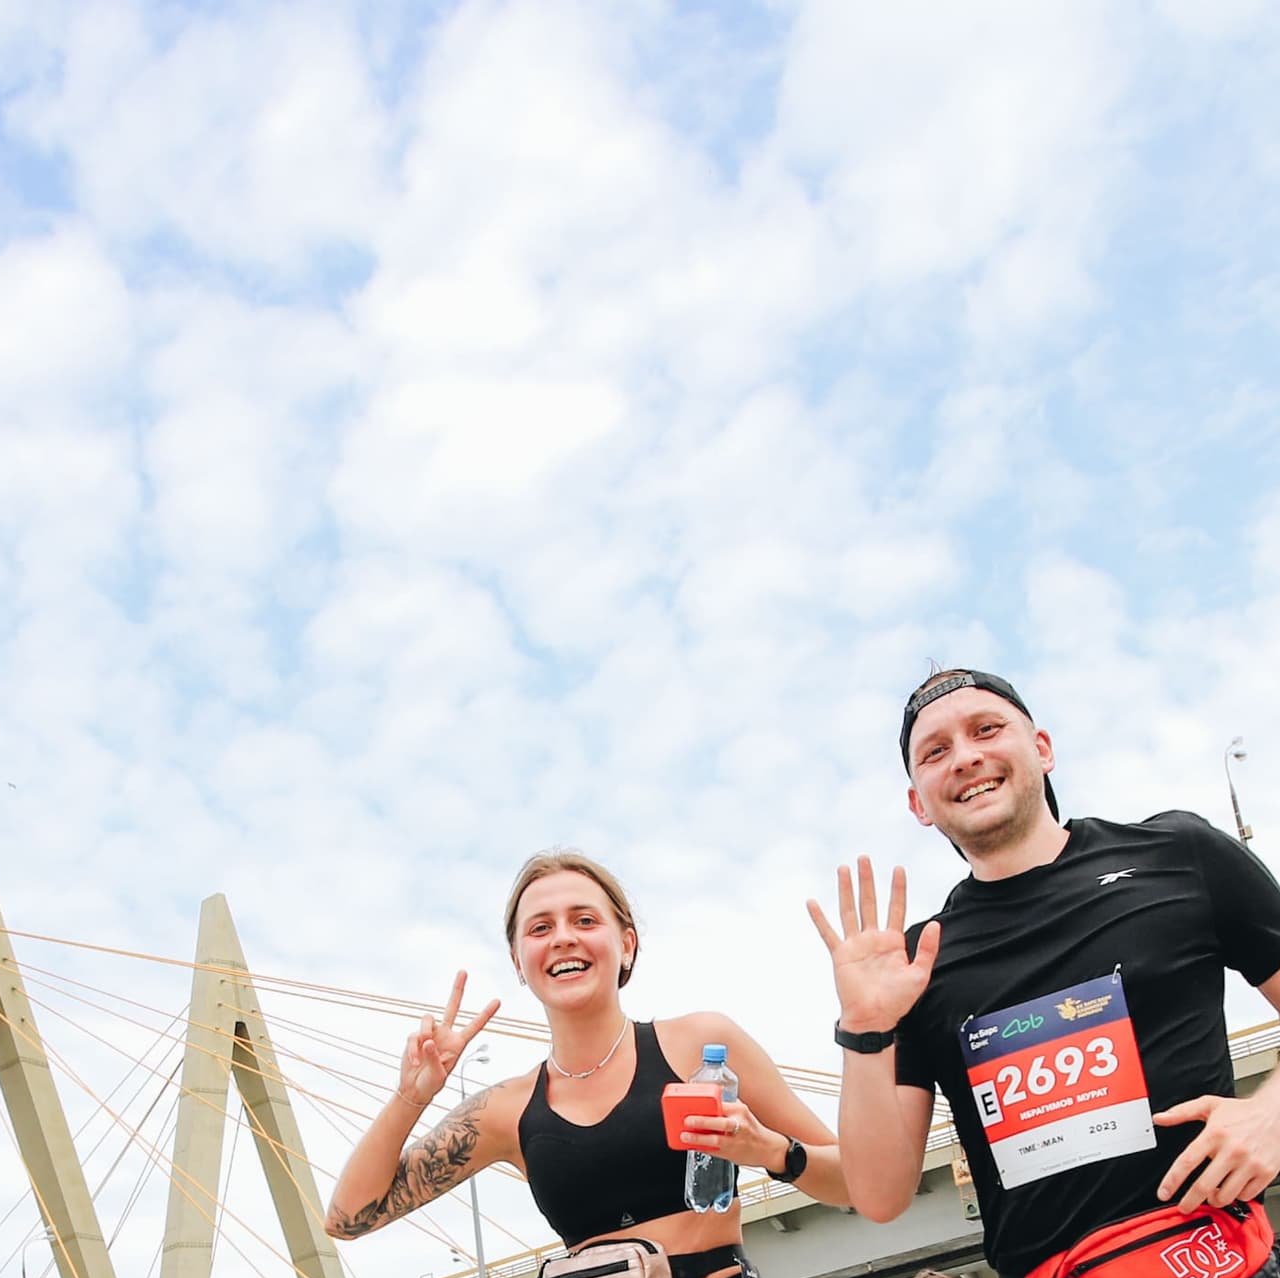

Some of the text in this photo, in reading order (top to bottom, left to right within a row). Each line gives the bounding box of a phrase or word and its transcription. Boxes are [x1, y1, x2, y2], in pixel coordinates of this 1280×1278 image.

[981, 1037, 1119, 1116] E 2693
[1076, 1087, 1109, 1103] МУРАТ
[1089, 1121, 1117, 1134] 2023
